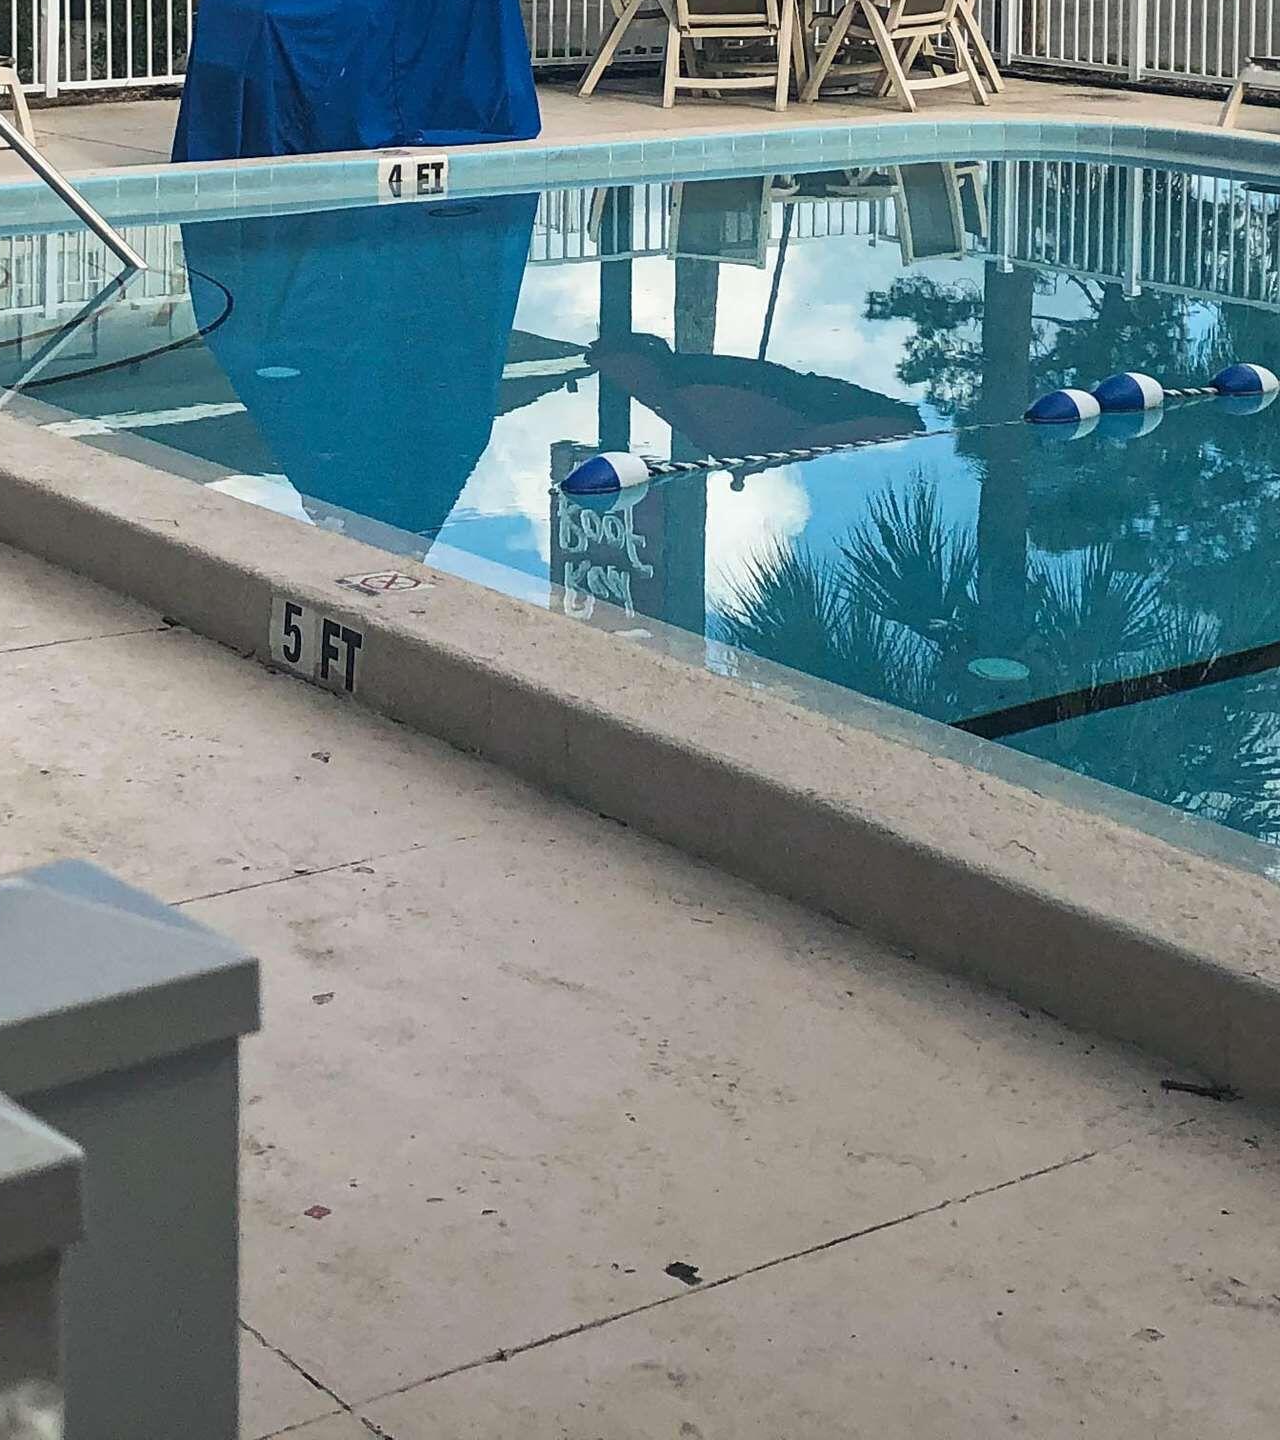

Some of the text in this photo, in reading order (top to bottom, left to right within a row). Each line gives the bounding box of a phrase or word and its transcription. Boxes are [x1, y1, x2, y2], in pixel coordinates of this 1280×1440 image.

[388, 164, 403, 193] 4
[283, 601, 362, 693] 5 FT
